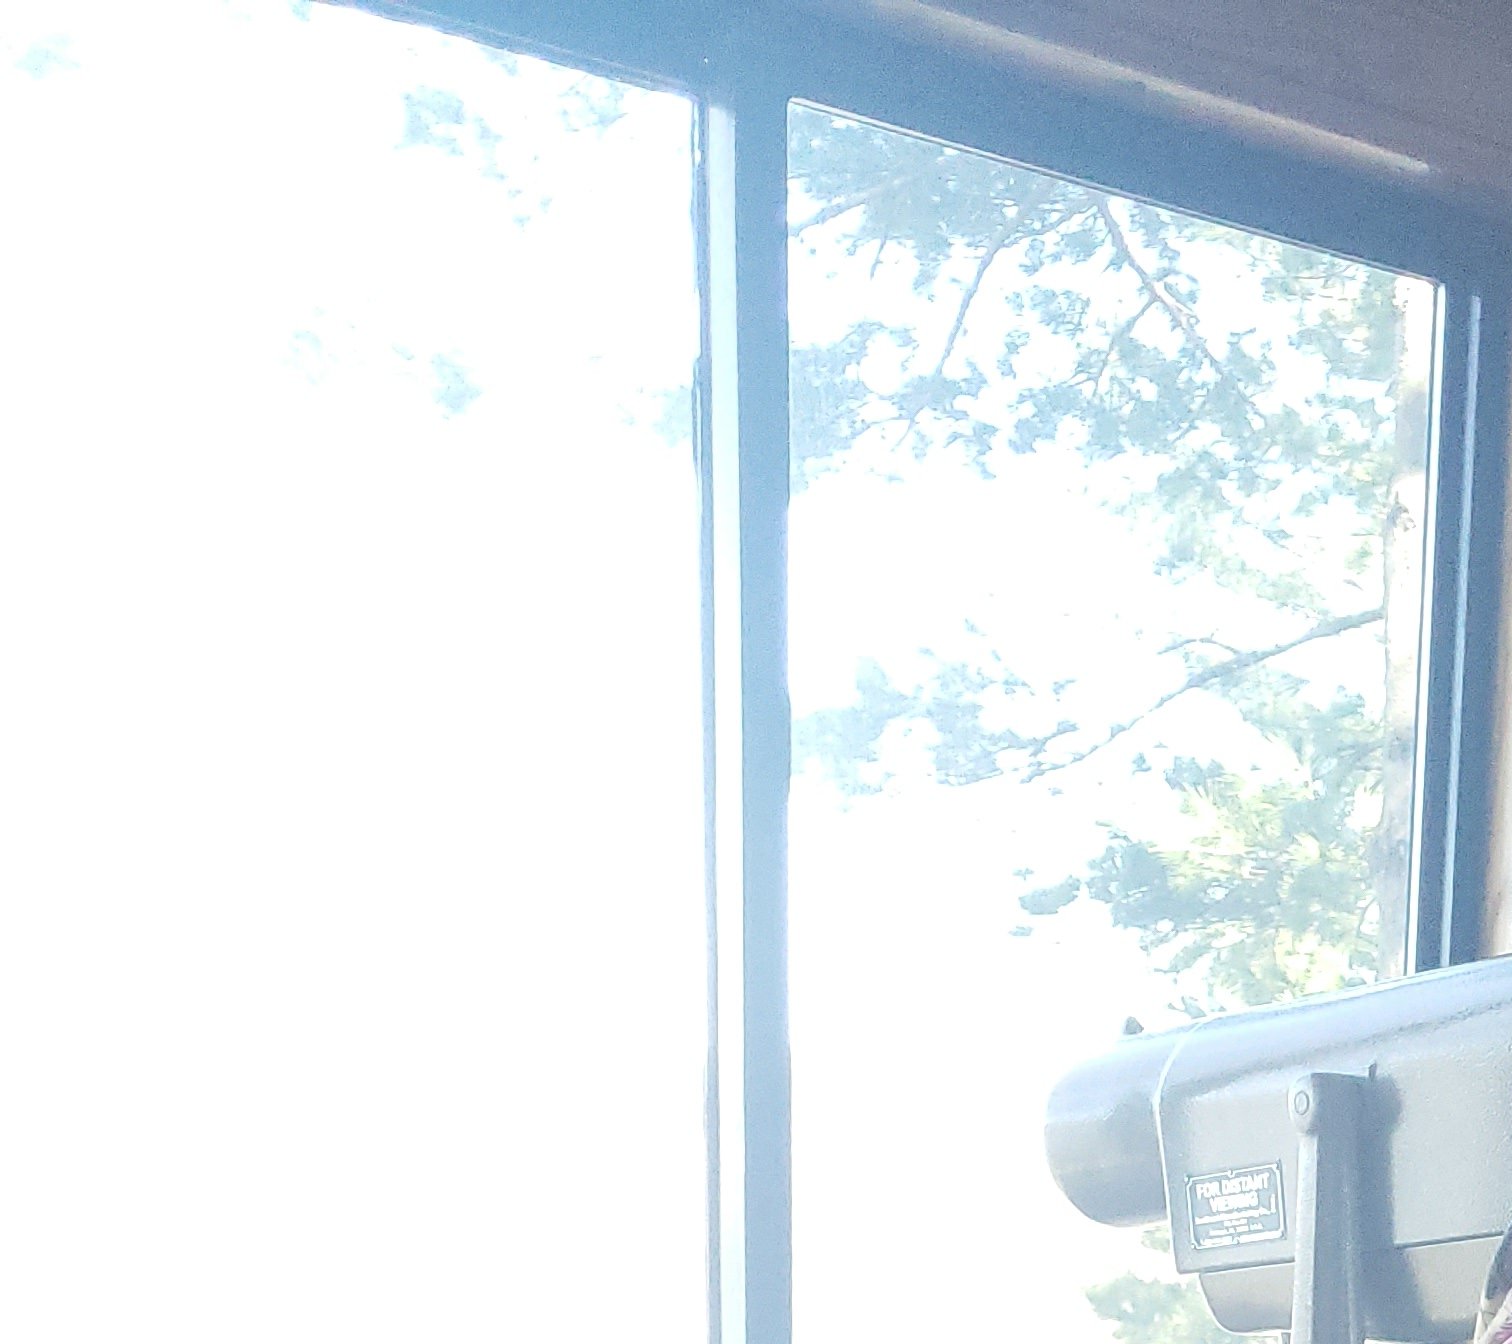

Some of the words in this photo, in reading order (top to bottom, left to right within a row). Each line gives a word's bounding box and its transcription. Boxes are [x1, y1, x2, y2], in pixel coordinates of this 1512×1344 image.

[1196, 1182, 1221, 1200] FOR
[1221, 1172, 1270, 1195] DISTANT
[1209, 1190, 1259, 1212] VIEWING
